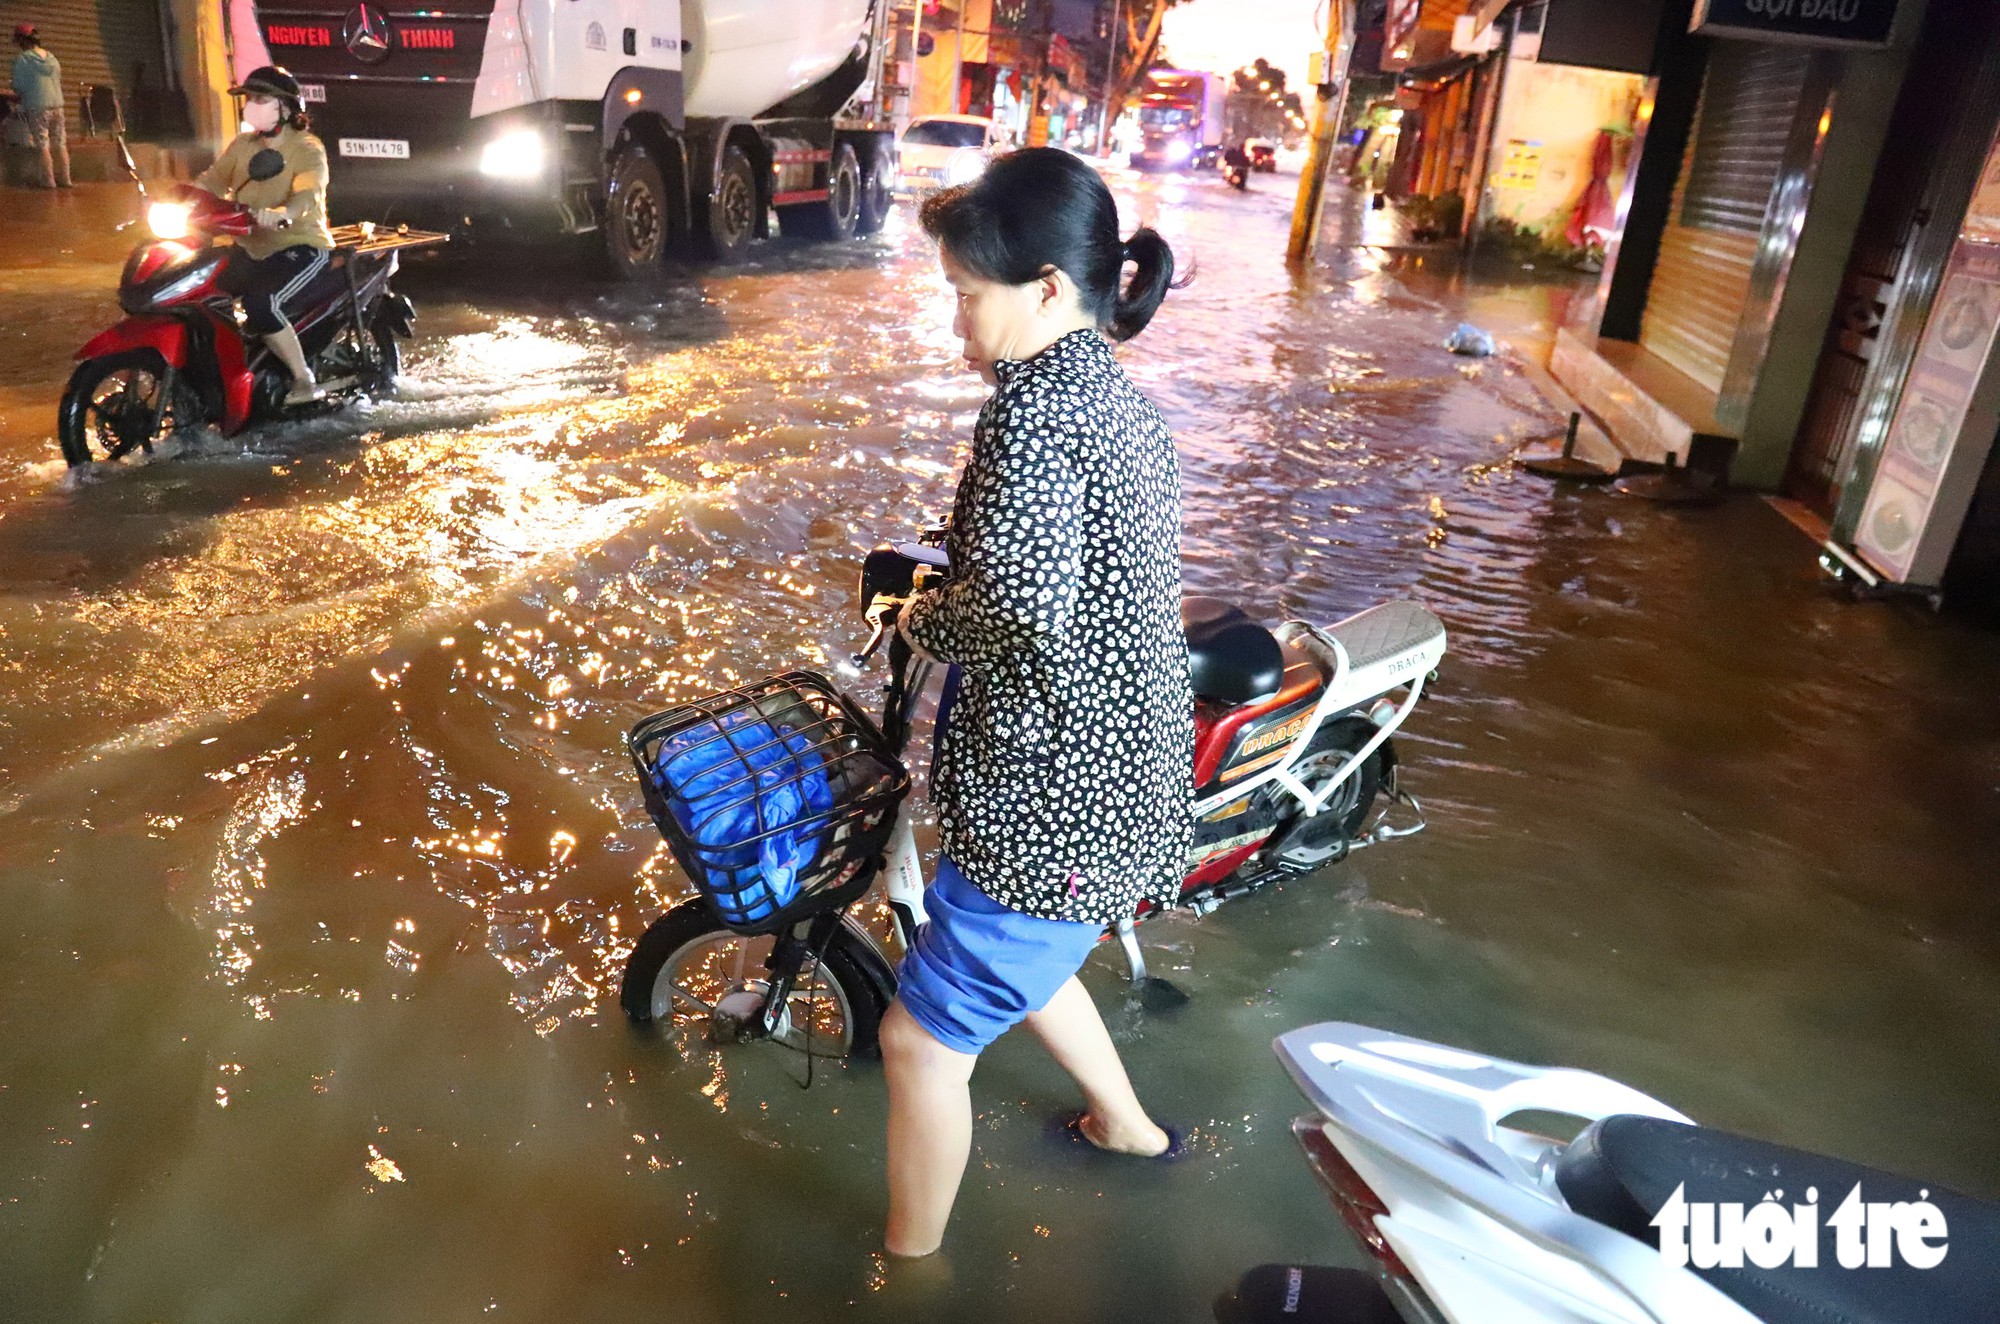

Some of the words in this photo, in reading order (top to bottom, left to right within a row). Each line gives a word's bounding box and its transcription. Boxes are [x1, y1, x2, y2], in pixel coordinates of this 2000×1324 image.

[268, 26, 331, 47] NGUYEN
[400, 29, 455, 49] THINH
[1388, 652, 1426, 675] DRACA
